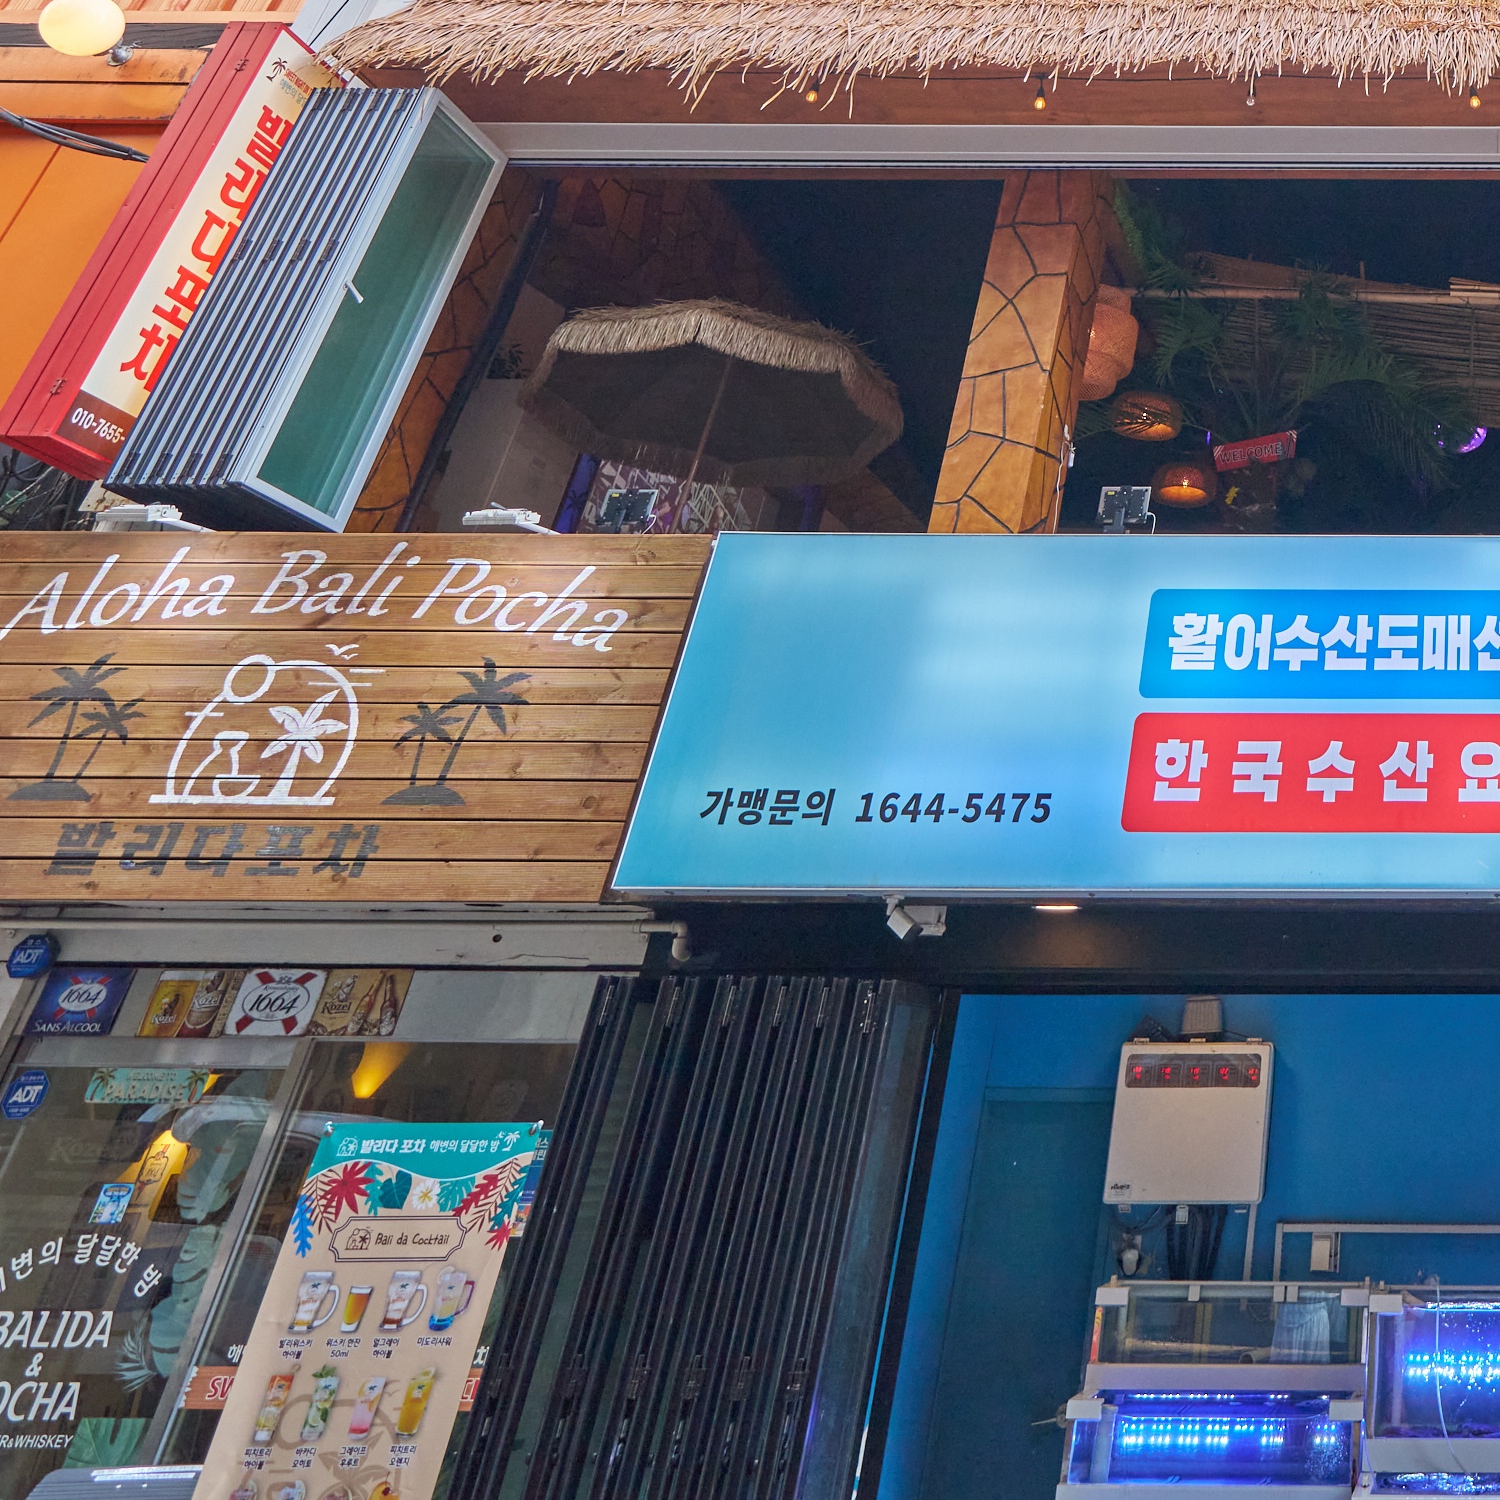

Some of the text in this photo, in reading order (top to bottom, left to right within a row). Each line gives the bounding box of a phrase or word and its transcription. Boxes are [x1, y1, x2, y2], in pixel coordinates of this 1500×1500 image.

[1219, 441, 1284, 465] WELCOME
[0, 541, 629, 653] Aloha Bali Pocha
[700, 787, 1053, 827] 가맹문의 1644-5475
[43, 819, 380, 878] 발리다포차
[12, 948, 45, 964] ADT
[61, 986, 105, 1003] 1664
[249, 993, 301, 1014] 1664
[321, 1001, 352, 1015] Kozel
[33, 1019, 62, 1032] SANS
[9, 1085, 44, 1103] ADT
[360, 1139, 500, 1154] 발리다 포차 해변의 달달한 밤
[375, 1232, 450, 1246] Bali da Cocktail
[74, 1233, 141, 1274] 달달한
[134, 1264, 162, 1298] 밤
[25, 1352, 43, 1377] &
[0, 1434, 74, 1449] R&WHISKEY
